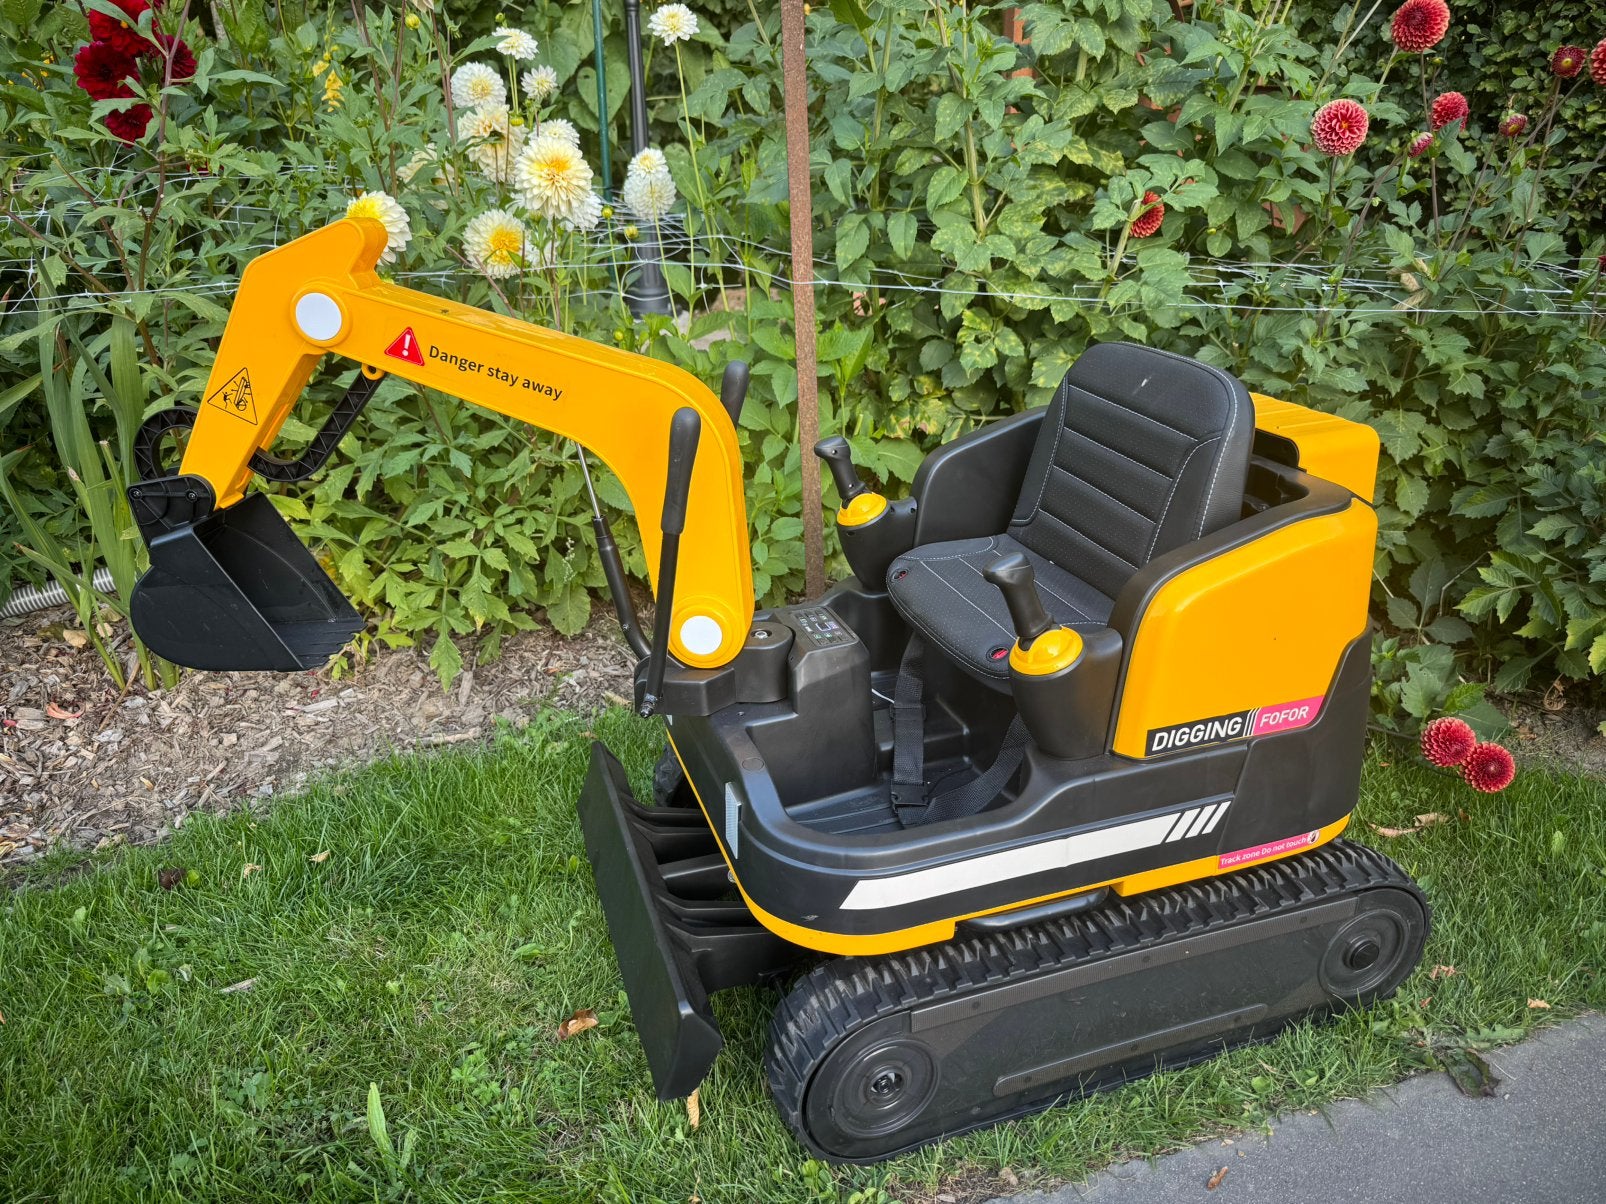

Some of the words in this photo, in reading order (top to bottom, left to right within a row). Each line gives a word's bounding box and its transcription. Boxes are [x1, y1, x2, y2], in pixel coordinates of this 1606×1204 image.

[429, 345, 484, 372] Danger
[487, 367, 519, 387] stay
[522, 378, 563, 401] away
[1152, 717, 1242, 751] DIGGING
[1260, 706, 1310, 728] FOFOR
[1221, 854, 1241, 865] Track
[1242, 850, 1260, 860] zone
[1261, 847, 1272, 855] Do
[1272, 843, 1285, 852] not
[1286, 837, 1307, 849] touch
